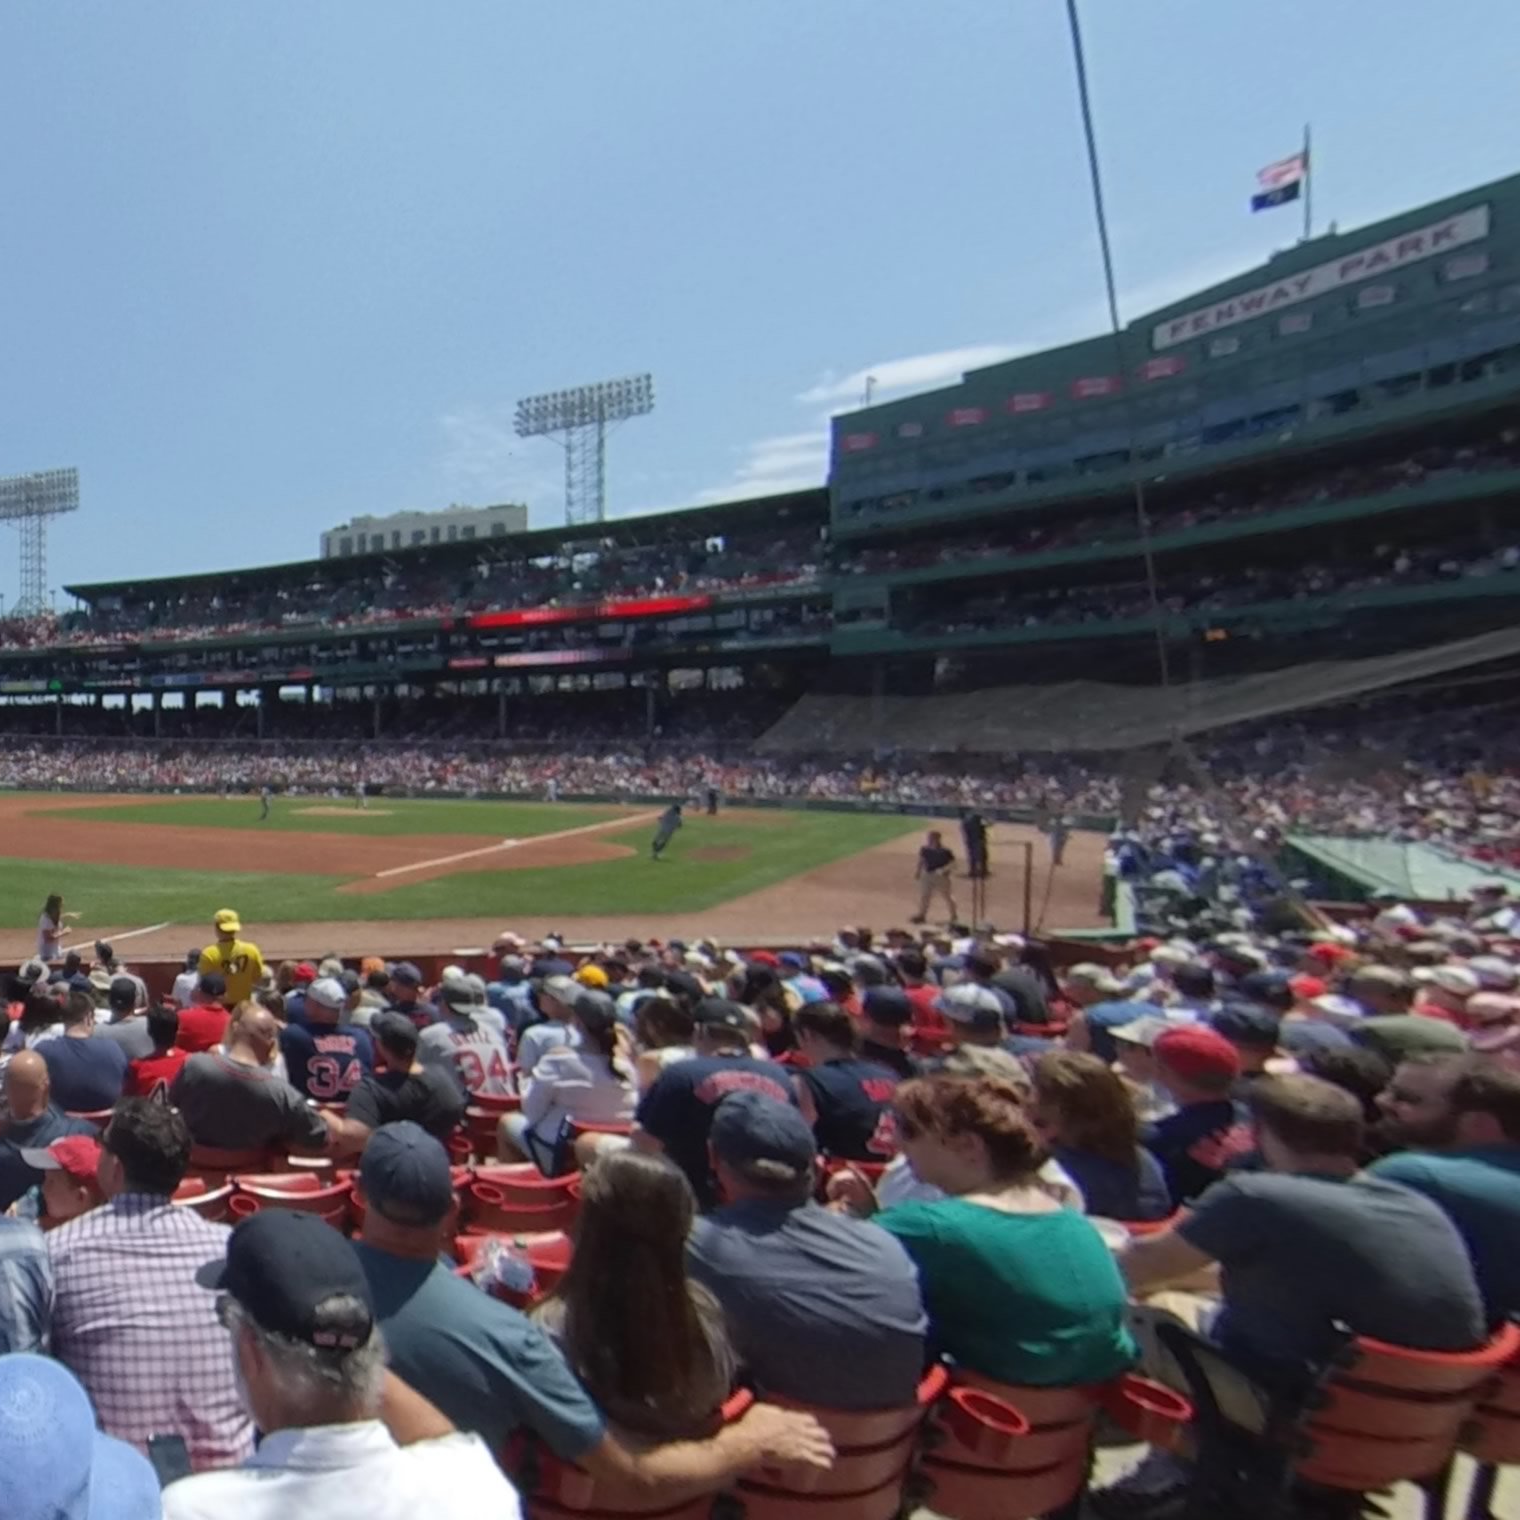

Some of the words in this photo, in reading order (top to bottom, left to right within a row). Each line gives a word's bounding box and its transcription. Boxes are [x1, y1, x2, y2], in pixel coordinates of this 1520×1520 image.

[1169, 274, 1313, 339] FENWAY
[1339, 221, 1460, 281] PARK
[307, 1055, 362, 1098] 34
[453, 1050, 508, 1091] 34
